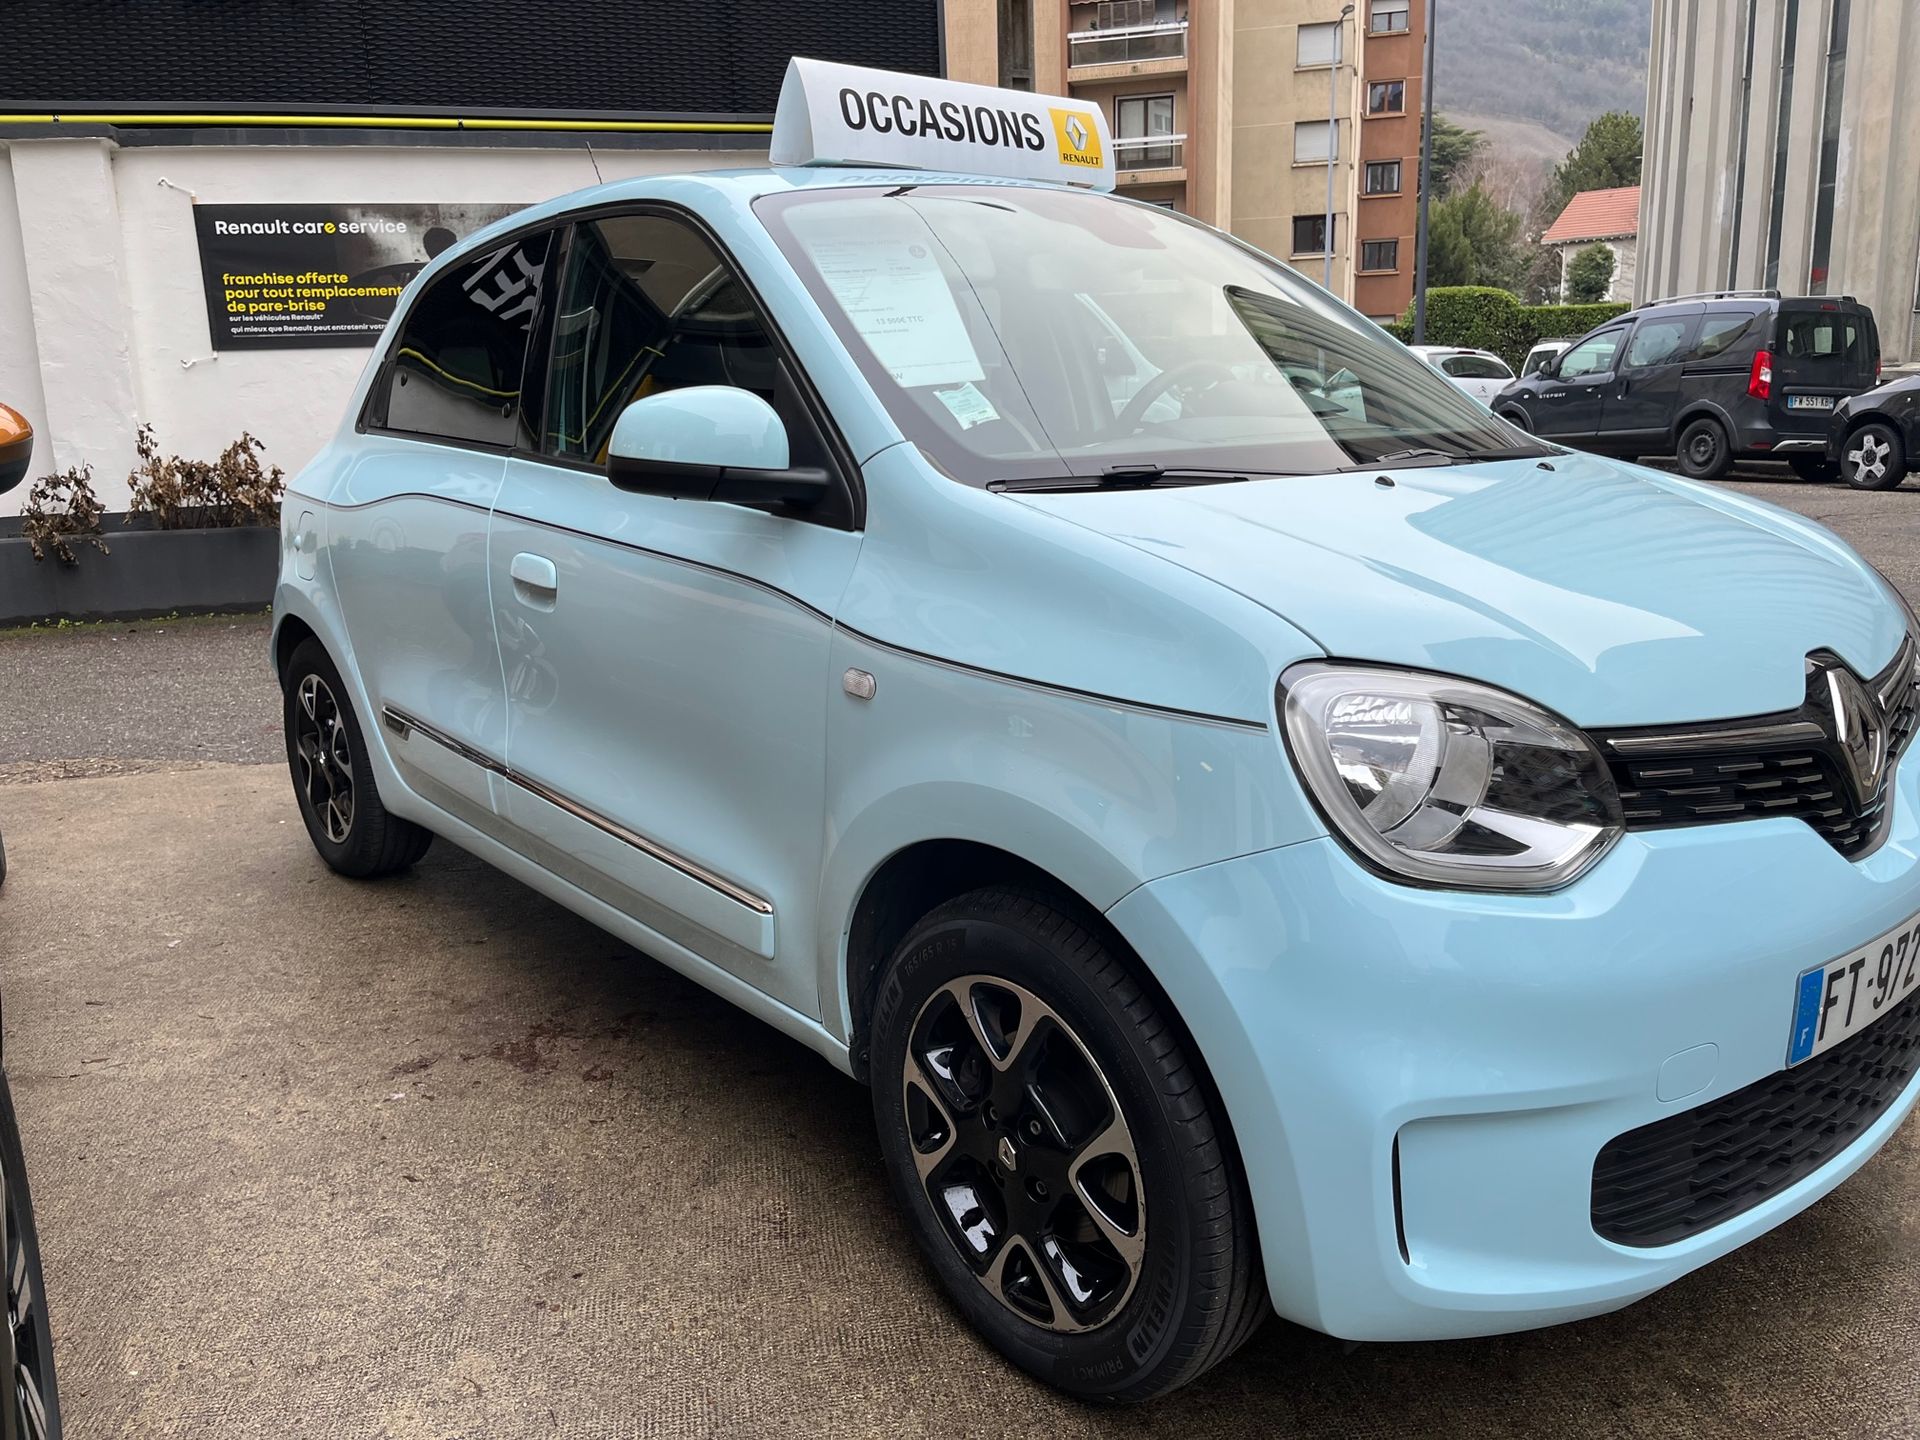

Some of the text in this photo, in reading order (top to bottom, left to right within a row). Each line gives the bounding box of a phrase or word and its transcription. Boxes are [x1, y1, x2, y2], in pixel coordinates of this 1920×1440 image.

[839, 87, 1045, 151] OCCASIONS
[1062, 152, 1100, 165] RENAULT
[215, 219, 407, 235] Renault care service
[223, 271, 349, 286] franchise offerte
[225, 285, 402, 302] pour tout remplacement
[227, 299, 326, 315] de pare-brise
[254, 313, 290, 321] véhicules
[230, 325, 243, 334] qui
[244, 325, 267, 333] mieux
[283, 324, 312, 332] Renault
[331, 323, 368, 331] entretenir
[1538, 391, 1567, 400] STEPWAY
[1800, 1027, 1809, 1047] F
